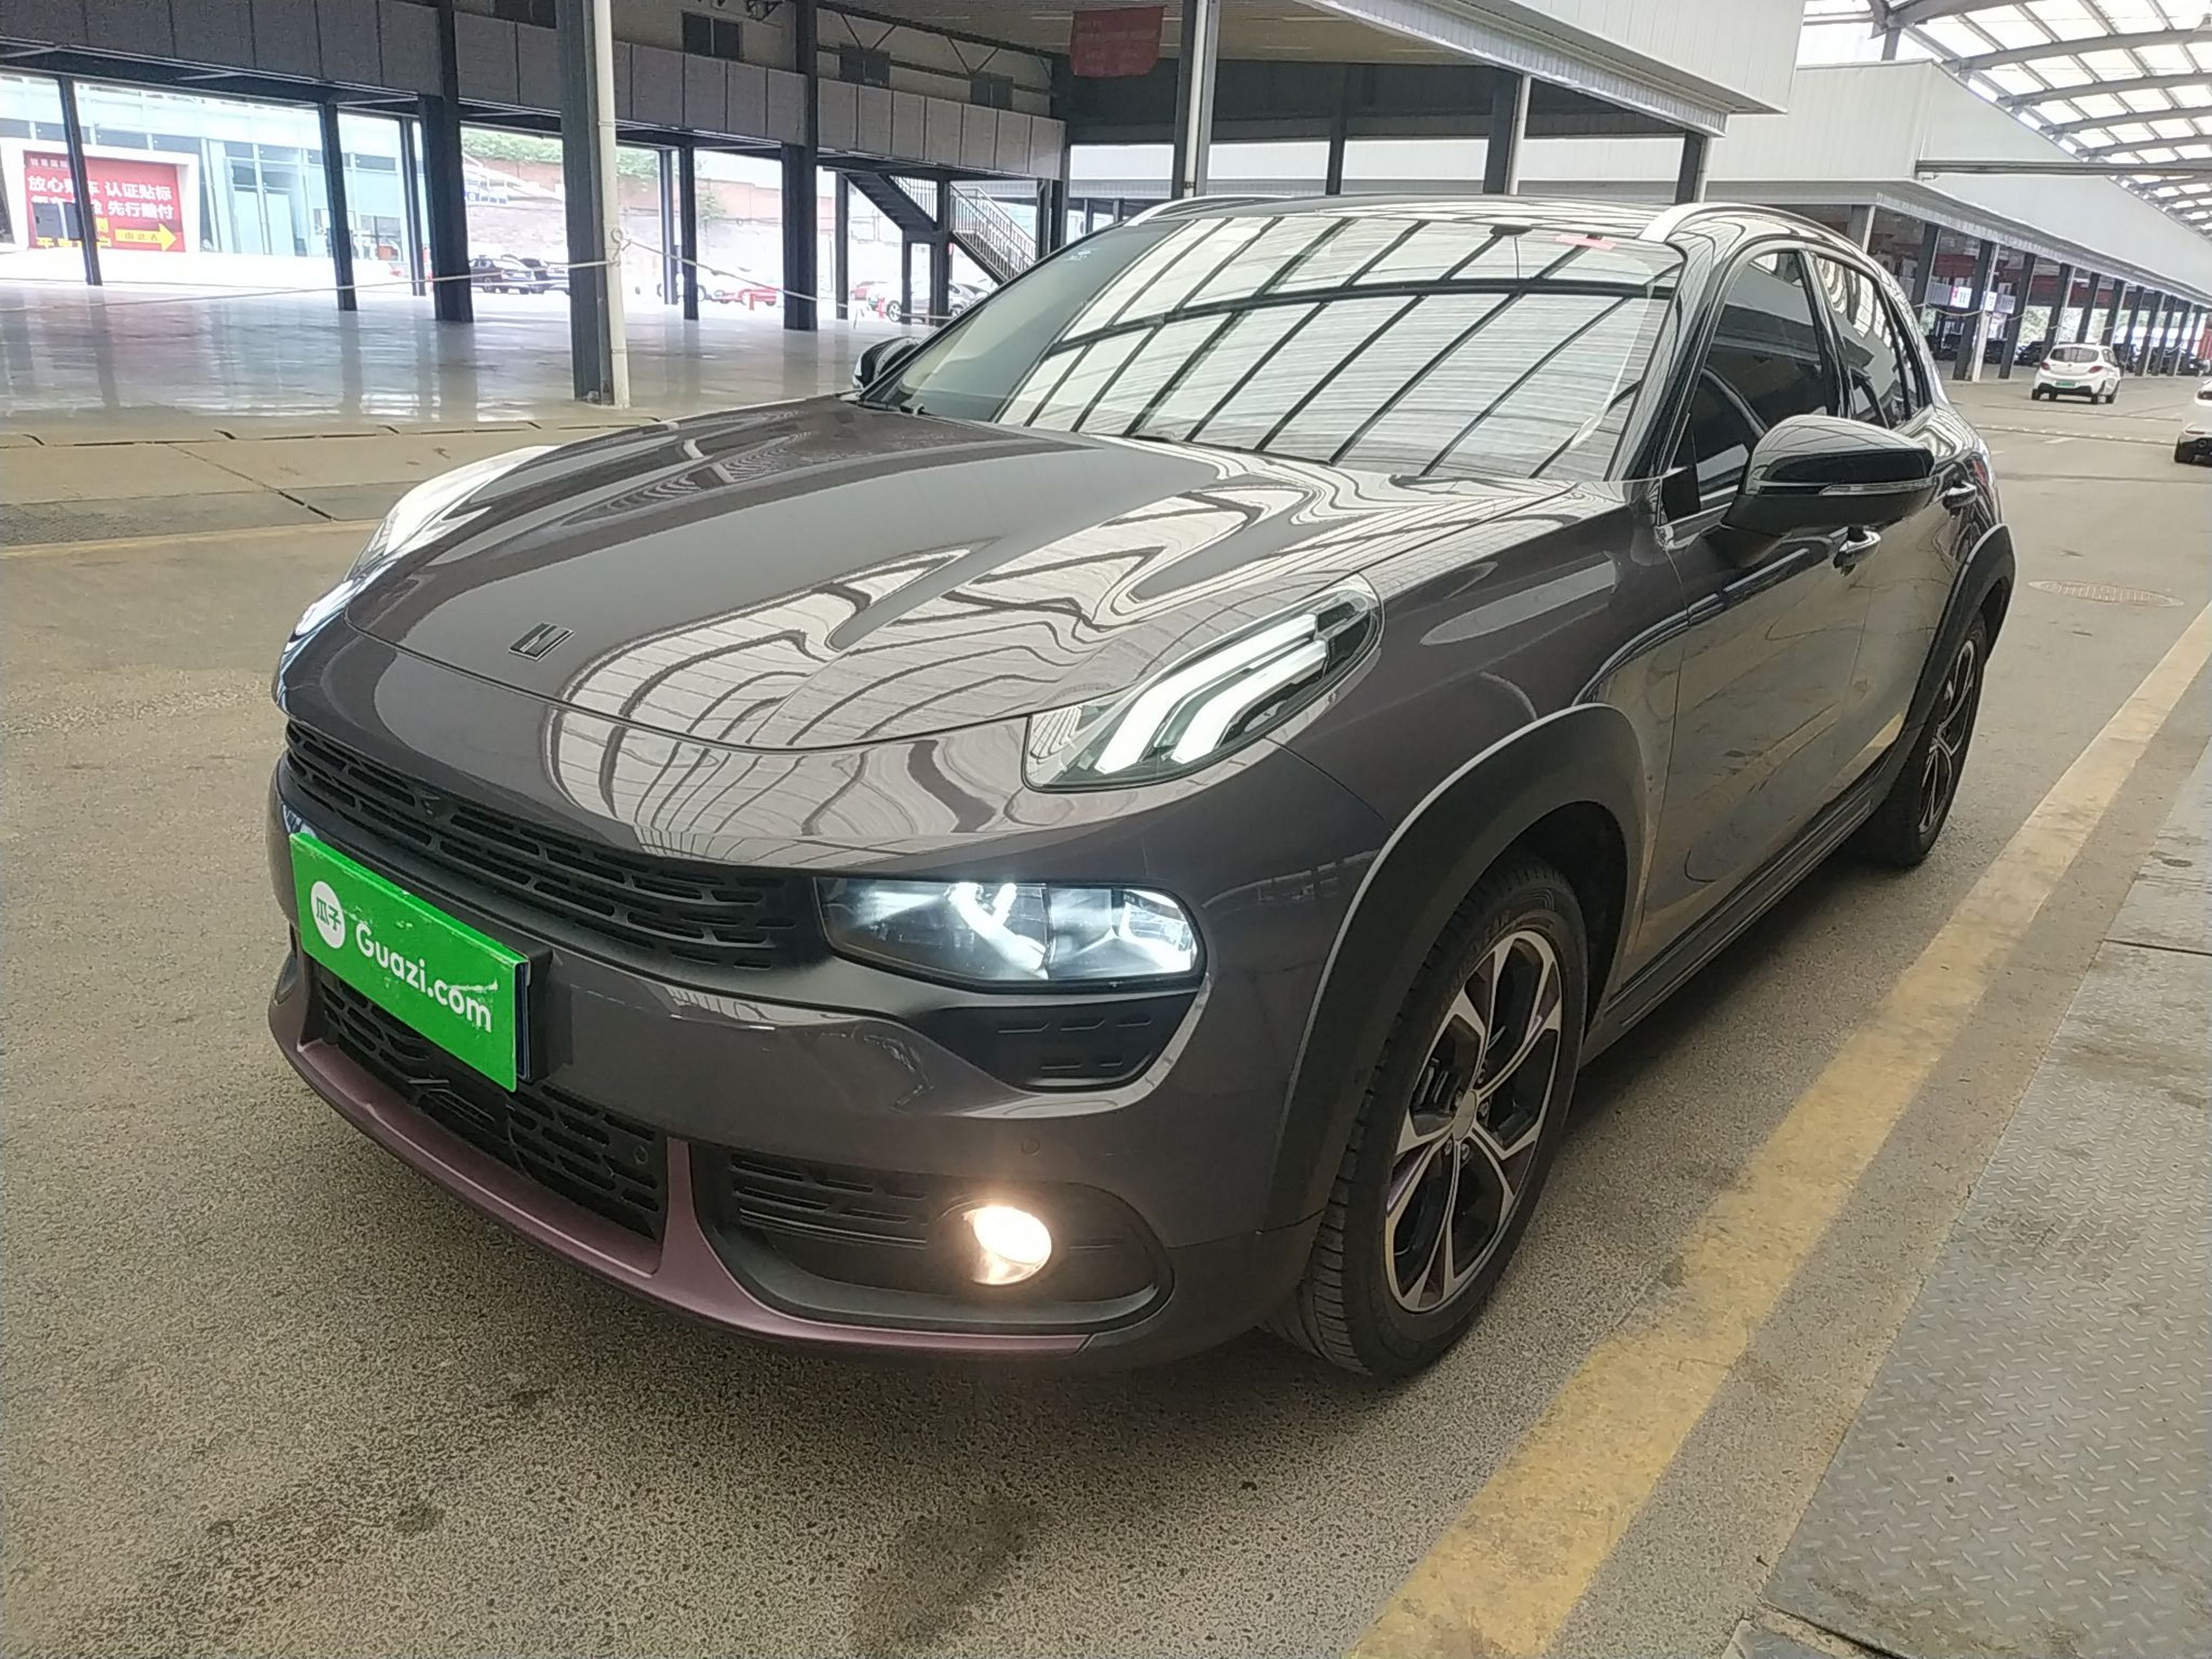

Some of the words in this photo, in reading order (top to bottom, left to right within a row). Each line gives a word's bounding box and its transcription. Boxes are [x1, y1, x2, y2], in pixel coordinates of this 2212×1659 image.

[104, 181, 172, 201] 认证贴标
[107, 200, 173, 219] 先行赔付
[316, 896, 341, 931] 瓜子
[355, 921, 491, 1033] Guazi.com
